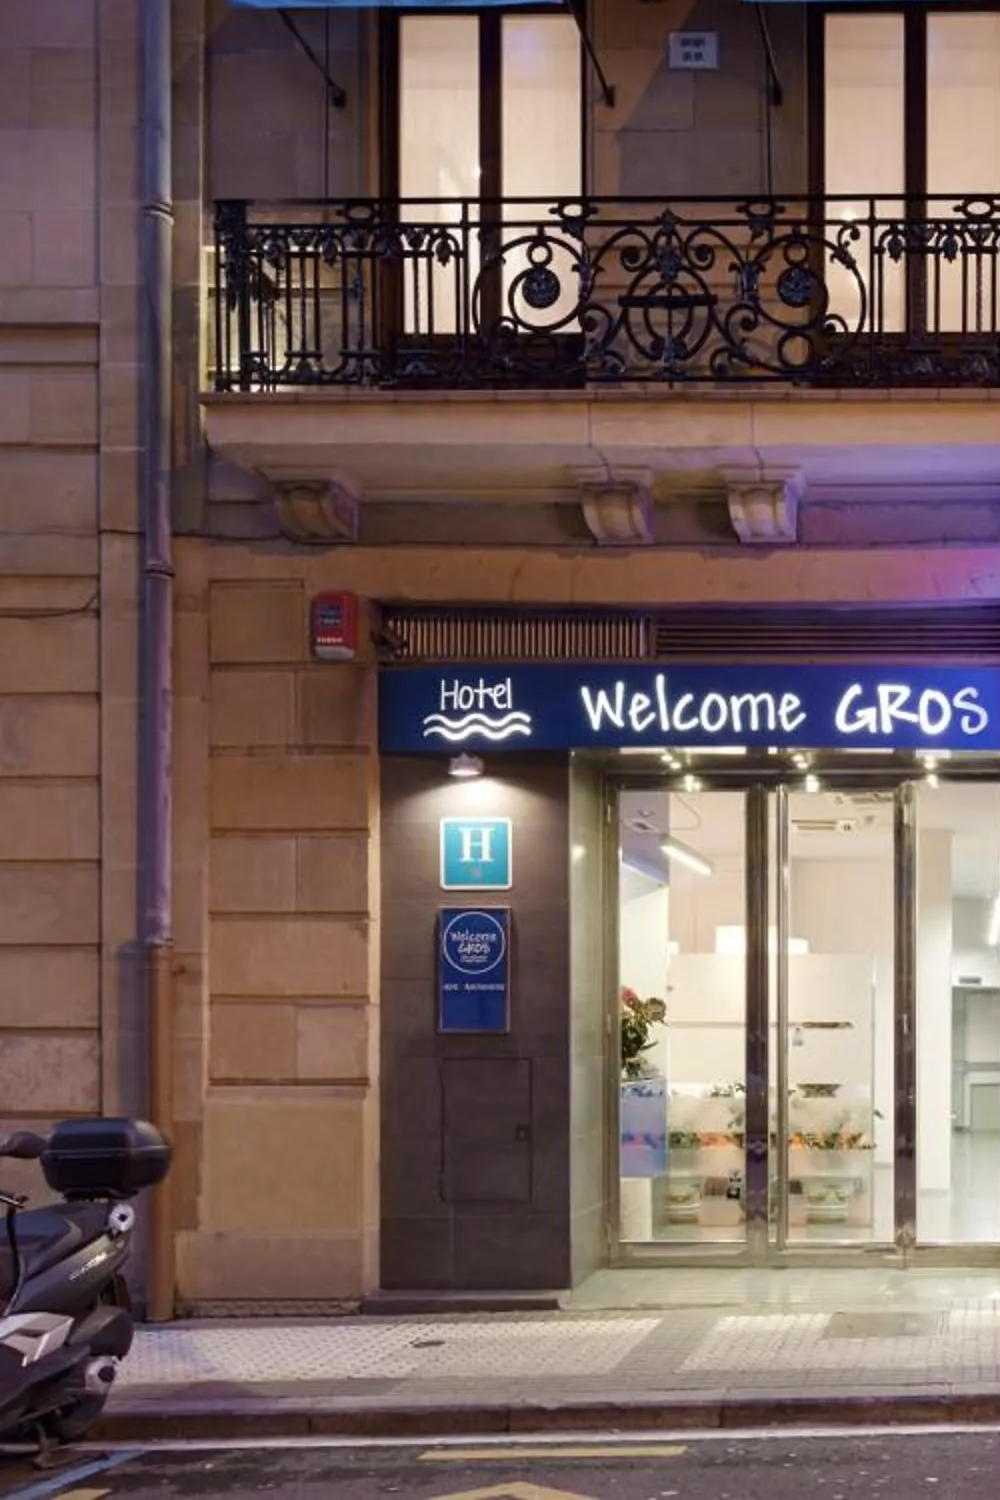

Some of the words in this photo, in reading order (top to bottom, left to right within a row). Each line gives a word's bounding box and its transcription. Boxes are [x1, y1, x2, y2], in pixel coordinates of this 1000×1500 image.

[440, 677, 513, 711] Hotel
[580, 673, 807, 733] Welcome
[834, 682, 989, 737] GROS
[458, 826, 496, 862] H
